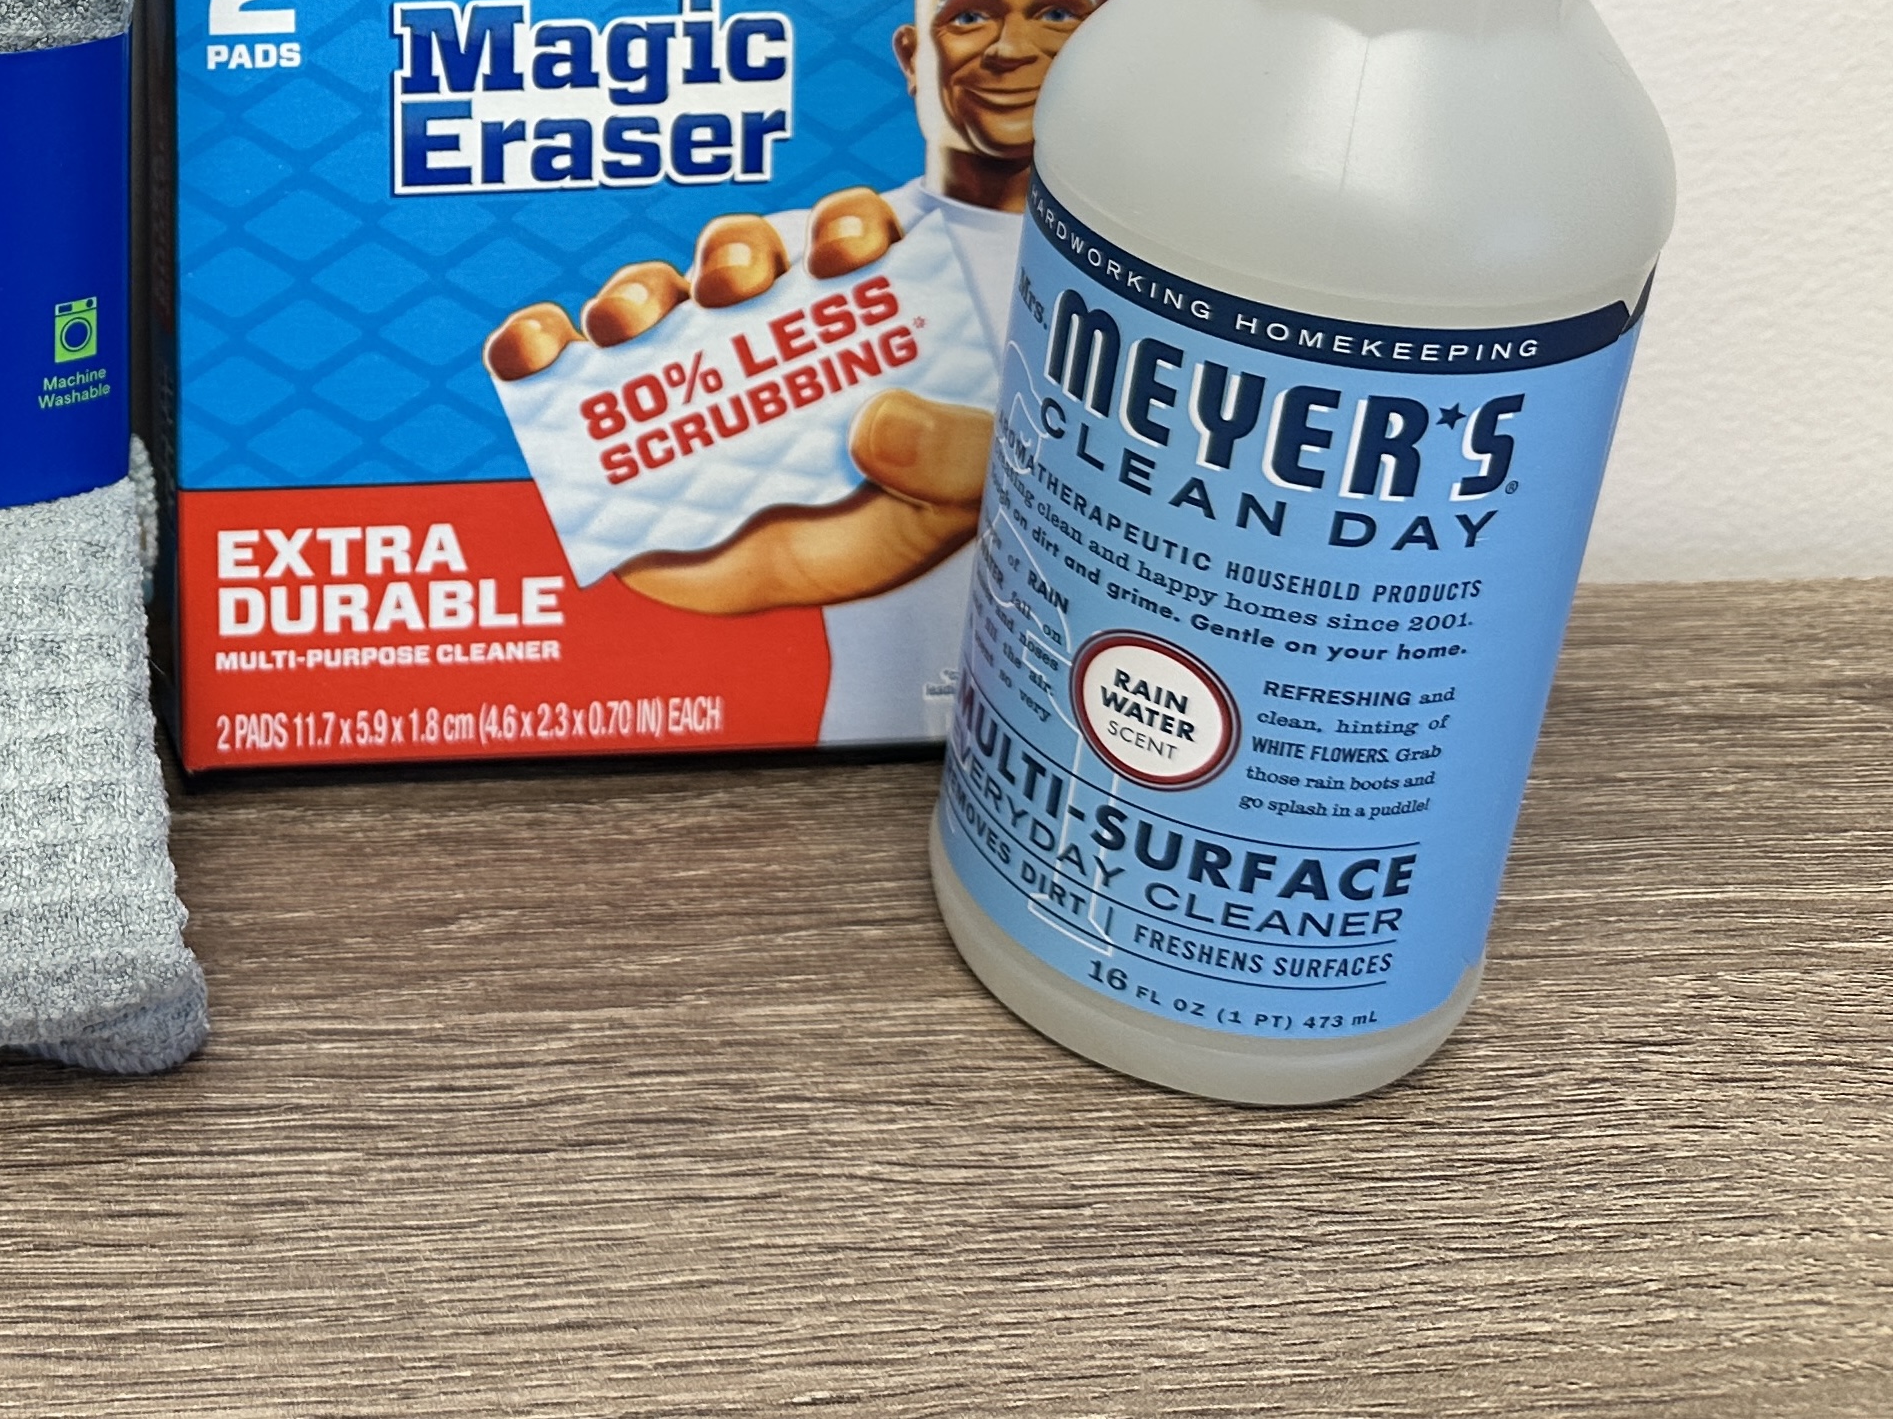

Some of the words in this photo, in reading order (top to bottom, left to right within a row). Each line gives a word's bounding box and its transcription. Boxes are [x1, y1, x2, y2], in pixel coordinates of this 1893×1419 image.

[207, 42, 301, 70] PADS
[396, 97, 790, 190] Eraser
[1031, 186, 1212, 320] HARDWORKING
[1235, 313, 1541, 362] HOMEKEEPING
[42, 368, 107, 392] Machine
[580, 349, 724, 441] 80%
[731, 275, 900, 378] LESS
[38, 382, 111, 410] Washable
[1040, 397, 1288, 537] CLEAN
[1328, 509, 1499, 551] DAY
[217, 523, 468, 579] EXTRA
[1037, 500, 1084, 546] clean
[1088, 537, 1131, 572] and
[1135, 559, 1219, 608] happy
[1224, 591, 1318, 628] homes
[1326, 612, 1400, 633] since
[1408, 612, 1474, 632] 2001.
[217, 576, 566, 637] DURABLE
[1013, 508, 1029, 531] on
[1031, 528, 1060, 558] dirt
[1064, 552, 1102, 586] and
[1106, 580, 1180, 621] grime.
[1190, 614, 1275, 648] Gentle
[1284, 640, 1318, 656] on
[1326, 646, 1389, 662] your
[1396, 643, 1468, 661] home.
[1225, 560, 1361, 601] HOUSEHOLD
[1372, 579, 1483, 604] PRODUCTS
[215, 644, 431, 671] MULTI-PURPOSE
[436, 640, 562, 664] CLEANER
[1100, 684, 1197, 743] WATER
[1113, 667, 1189, 715] RAIN
[1262, 680, 1412, 707] REFRESHING
[1418, 686, 1456, 705] and
[215, 714, 231, 751] 2
[234, 711, 289, 750] PADS
[294, 710, 337, 748] 11.7
[356, 708, 389, 745] 5.9
[408, 706, 440, 744] 1.8
[442, 711, 475, 742] cm
[479, 701, 519, 748] (4.6
[537, 701, 571, 739] 2.3
[588, 698, 634, 738] 0.70
[668, 694, 725, 734] EACH
[1107, 719, 1178, 760] SCENT
[1251, 735, 1306, 760] WHITE
[1395, 744, 1443, 763] Grab
[1256, 710, 1324, 733] clean,
[1334, 718, 1420, 737] hinting
[1427, 713, 1451, 731] of
[958, 669, 1418, 902] MULTI-SURFACE
[1245, 765, 1301, 787] those
[1305, 774, 1345, 791] rain
[1349, 773, 1400, 791] boots
[1404, 770, 1437, 788] and
[1238, 794, 1264, 810] go
[1267, 798, 1328, 817] splash
[1331, 801, 1351, 818] in
[1368, 797, 1431, 821] puddle!
[1020, 859, 1087, 915] DIRT
[1133, 923, 1265, 974] FRESHENS
[1272, 951, 1394, 979] SURFACES
[1144, 882, 1404, 938] CLEANER
[1087, 958, 1129, 992] 16
[1135, 984, 1162, 1006] FL
[1172, 998, 1207, 1018] OZ
[1216, 1007, 1243, 1025] (1
[1253, 1013, 1293, 1032] PT)
[1302, 1014, 1344, 1029] 473
[1351, 1010, 1379, 1026] mL
